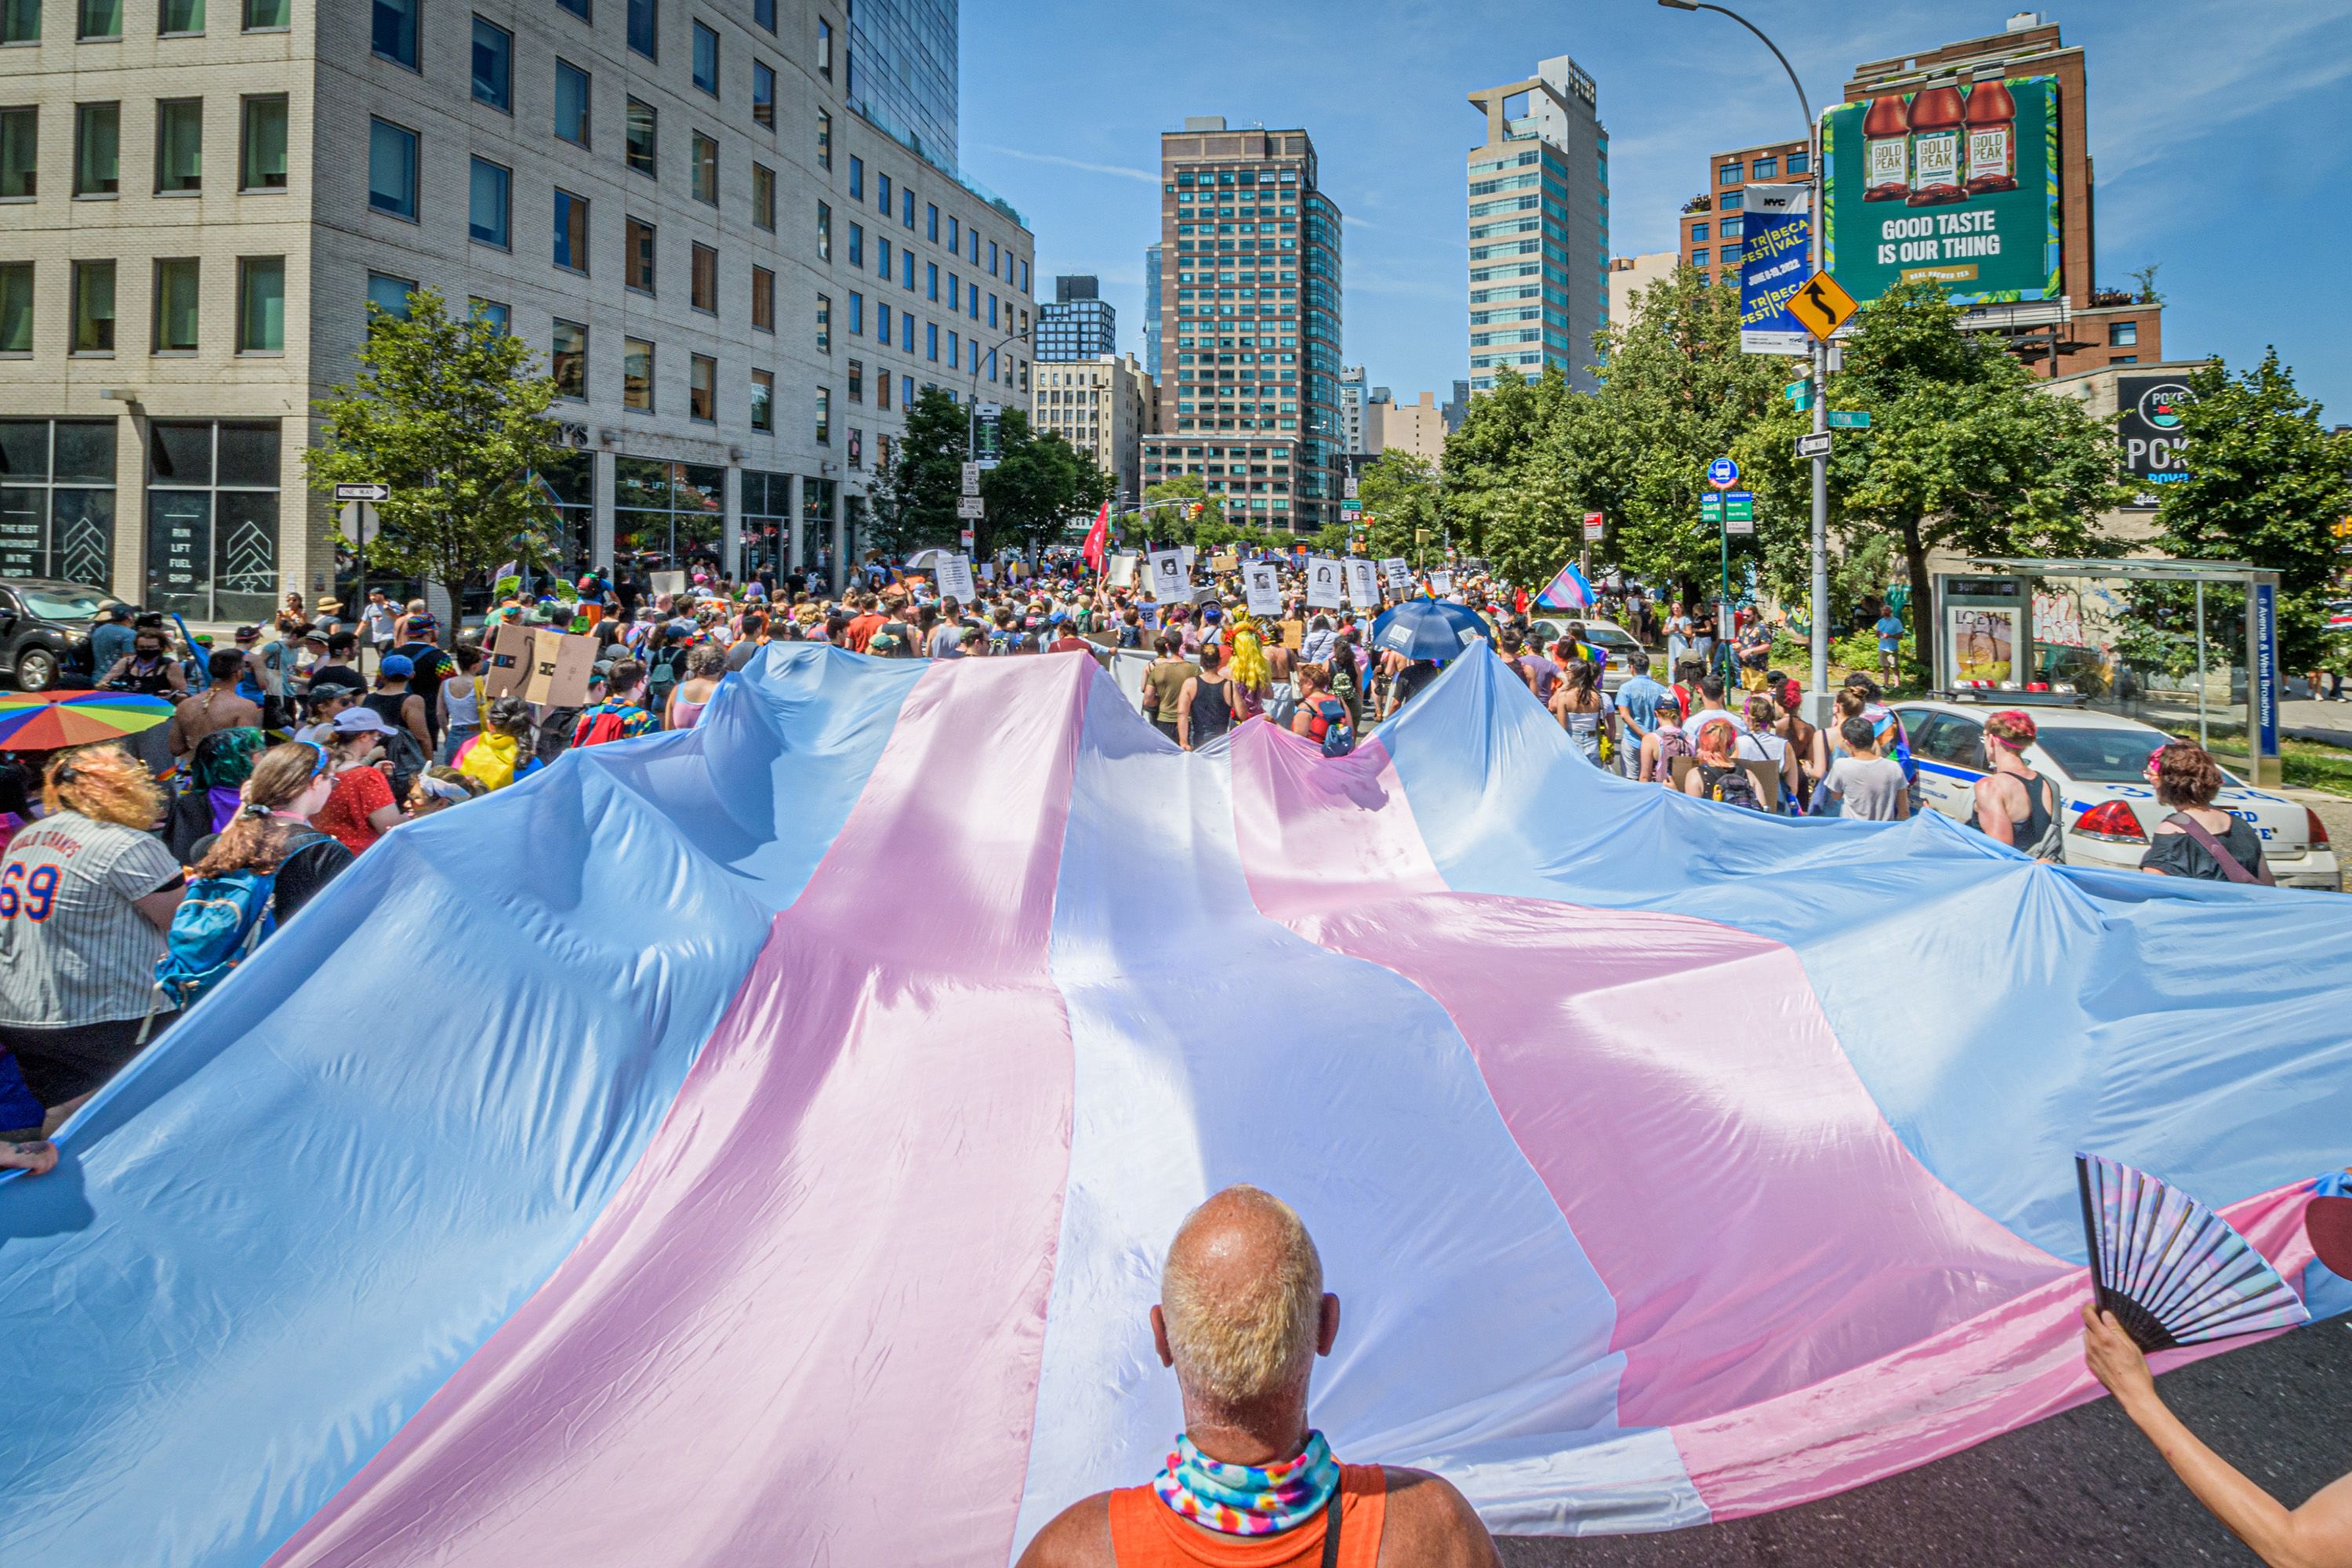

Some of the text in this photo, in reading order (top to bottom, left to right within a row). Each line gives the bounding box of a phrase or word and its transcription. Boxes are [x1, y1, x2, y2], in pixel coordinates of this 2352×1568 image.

[1921, 139, 1951, 155] GOLD
[1973, 133, 2002, 147] GOLD
[1875, 144, 1901, 158] GOLD
[1973, 146, 2002, 160] PEAK
[1875, 156, 1901, 169] PEAK
[1921, 153, 1952, 168] PEAK
[1764, 198, 1786, 206] NYC
[1882, 210, 1995, 240] GOOD TASTE
[1878, 234, 2001, 264] IS OUR THING
[1910, 272, 1926, 281] REAL
[1832, 414, 1853, 425] YORK
[172, 528, 191, 538] RUN
[171, 543, 191, 553] LIFT
[5, 554, 32, 563] IN THE
[169, 558, 192, 568] FUEL
[169, 574, 193, 583] SHOP
[1141, 612, 1153, 622] 42
[1955, 610, 2013, 626] LOEWE
[2258, 607, 2269, 641] Avenue
[2259, 653, 2270, 677] West
[2260, 680, 2270, 728] Broadway
[41, 830, 82, 859] CHAMPS
[0, 861, 64, 924] 69
